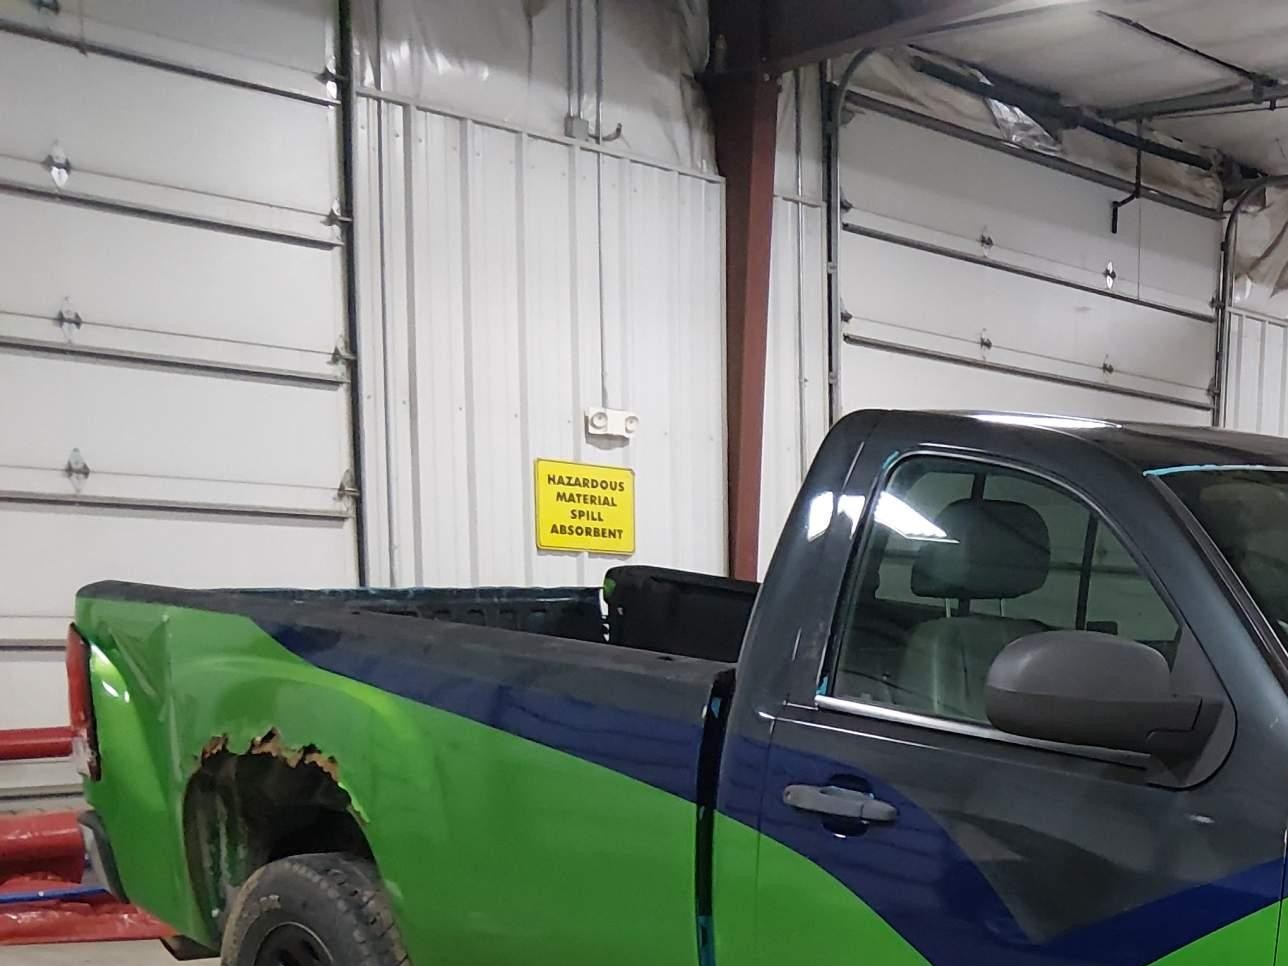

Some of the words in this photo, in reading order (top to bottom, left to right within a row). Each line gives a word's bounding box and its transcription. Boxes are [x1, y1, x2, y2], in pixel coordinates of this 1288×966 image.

[547, 474, 625, 492] HAZARDOUS
[556, 491, 617, 507] MATERIAL
[570, 509, 604, 522] SPILL
[550, 523, 624, 540] ABSORBENT
